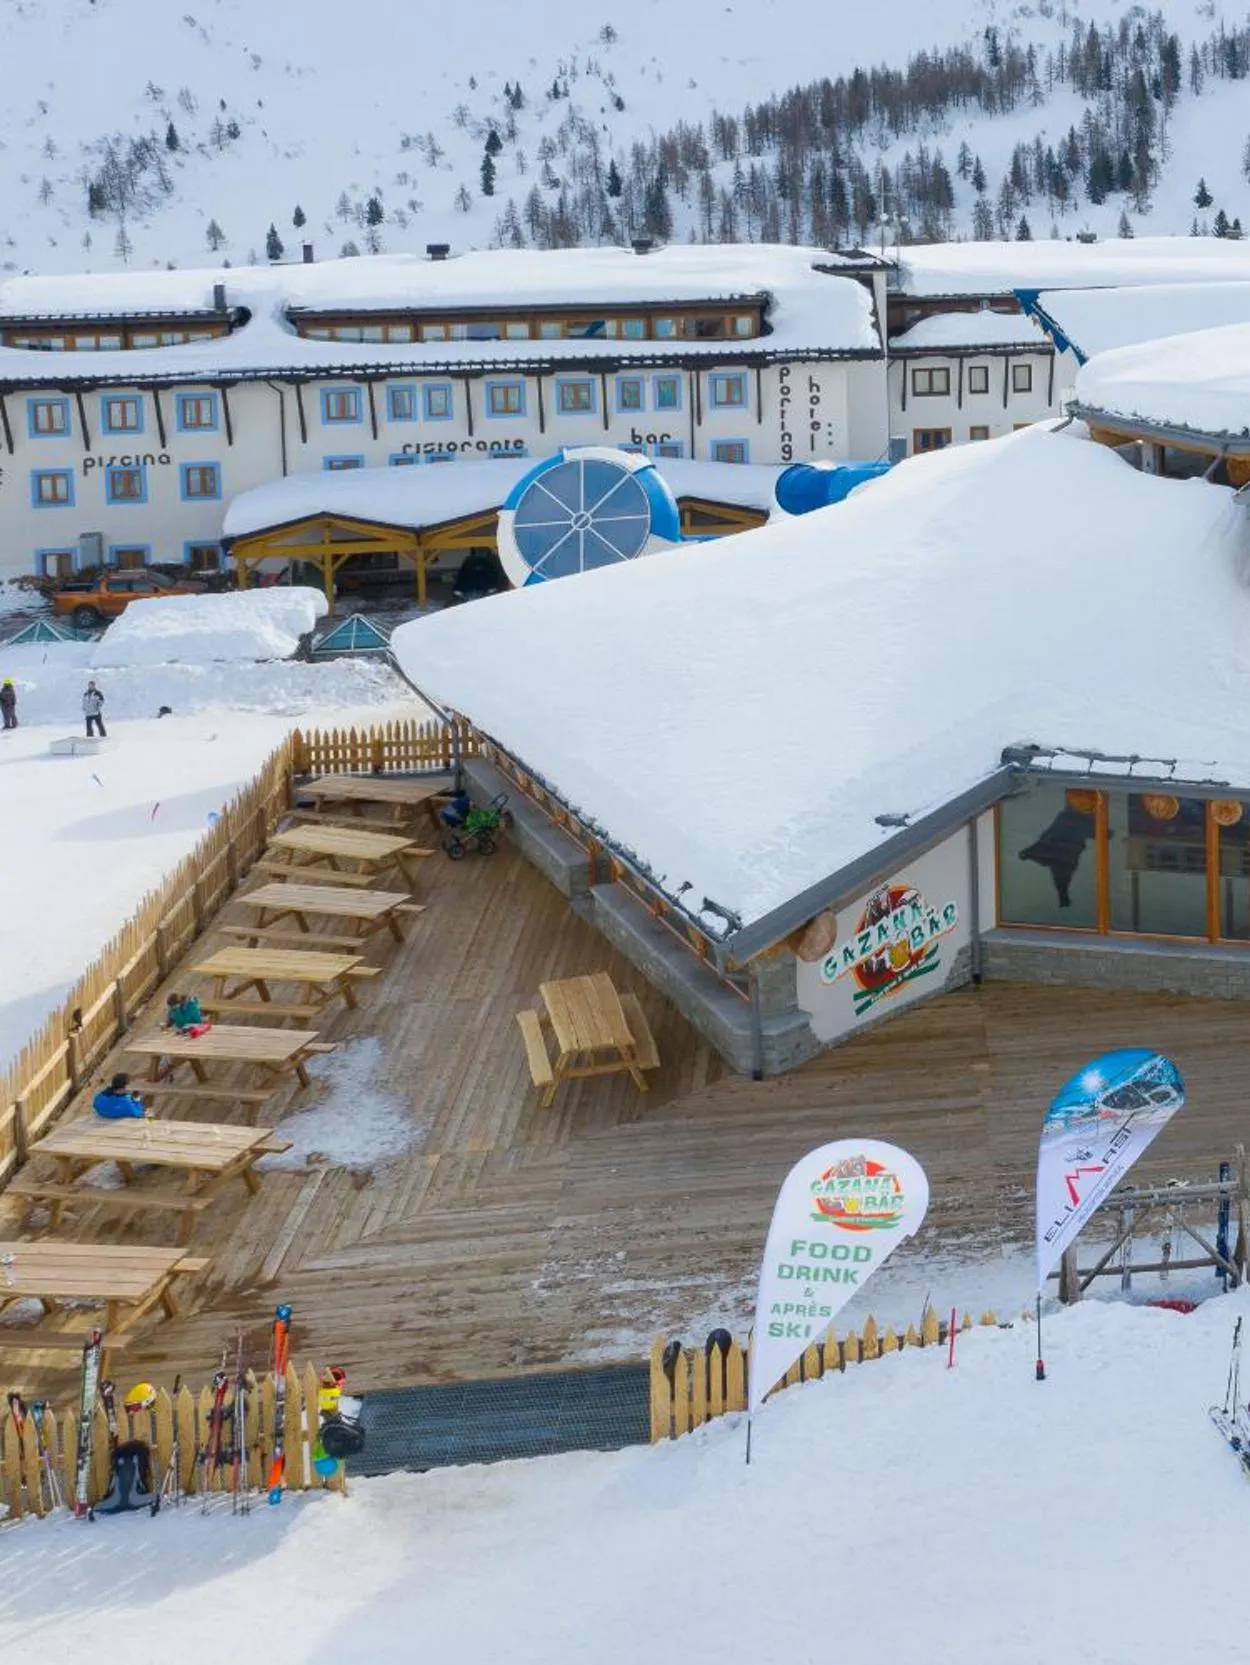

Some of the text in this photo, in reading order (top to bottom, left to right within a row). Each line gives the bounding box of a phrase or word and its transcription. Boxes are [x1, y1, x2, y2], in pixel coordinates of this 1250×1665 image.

[808, 375, 821, 452] hotel
[630, 427, 672, 445] bar
[401, 437, 525, 455] ristorante
[82, 451, 172, 477] piscina
[789, 1239, 873, 1264] FOOD
[777, 1263, 859, 1285] DRINK
[804, 1286, 815, 1298] &
[770, 1301, 832, 1319] APRÈS
[767, 1322, 812, 1339] SKI
